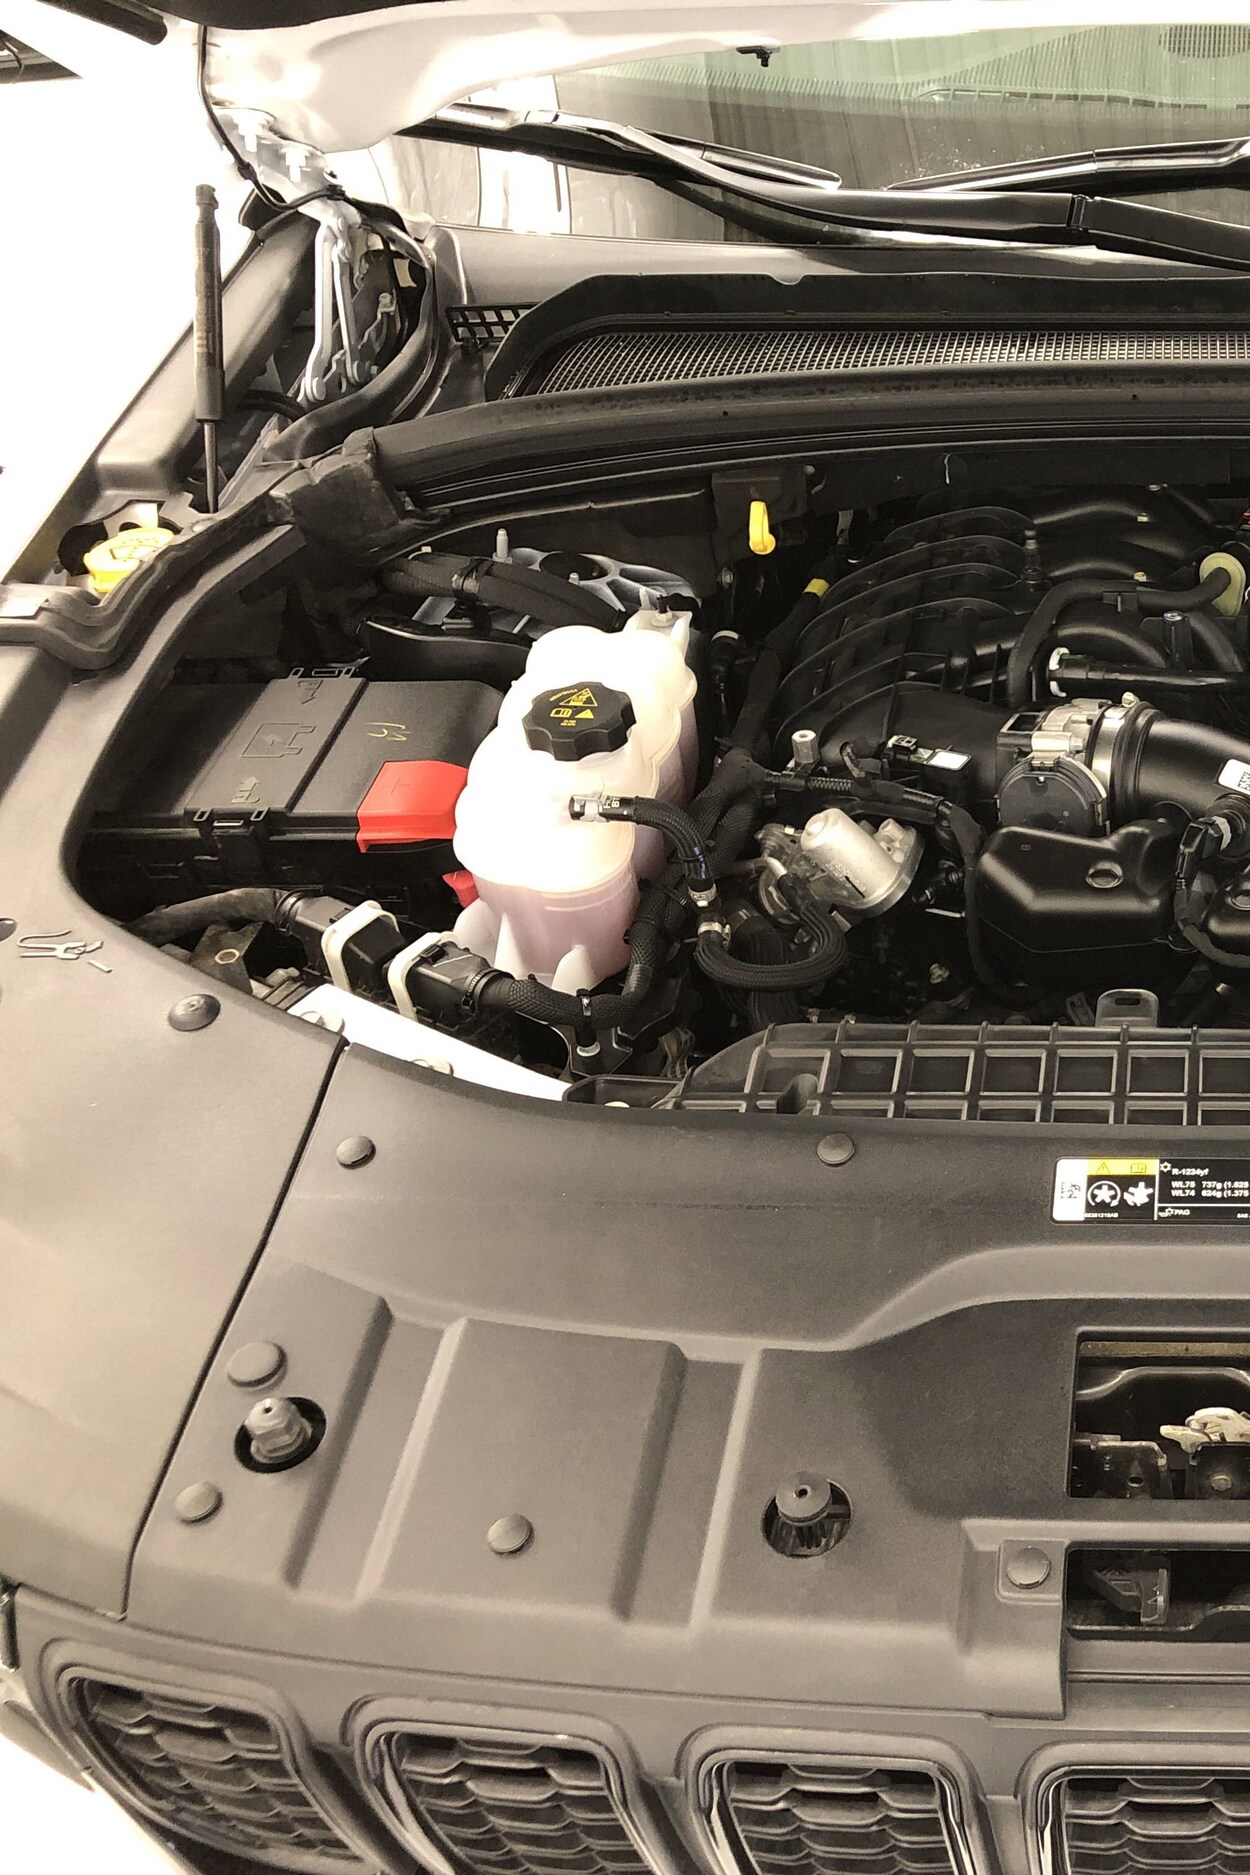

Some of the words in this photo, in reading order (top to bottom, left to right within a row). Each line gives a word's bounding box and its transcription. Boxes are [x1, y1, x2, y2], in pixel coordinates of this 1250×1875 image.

[1171, 1167, 1210, 1177] R-1234yf
[1171, 1181, 1196, 1189] WL75
[1201, 1181, 1223, 1190] 737g
[1171, 1189, 1196, 1197] WL74
